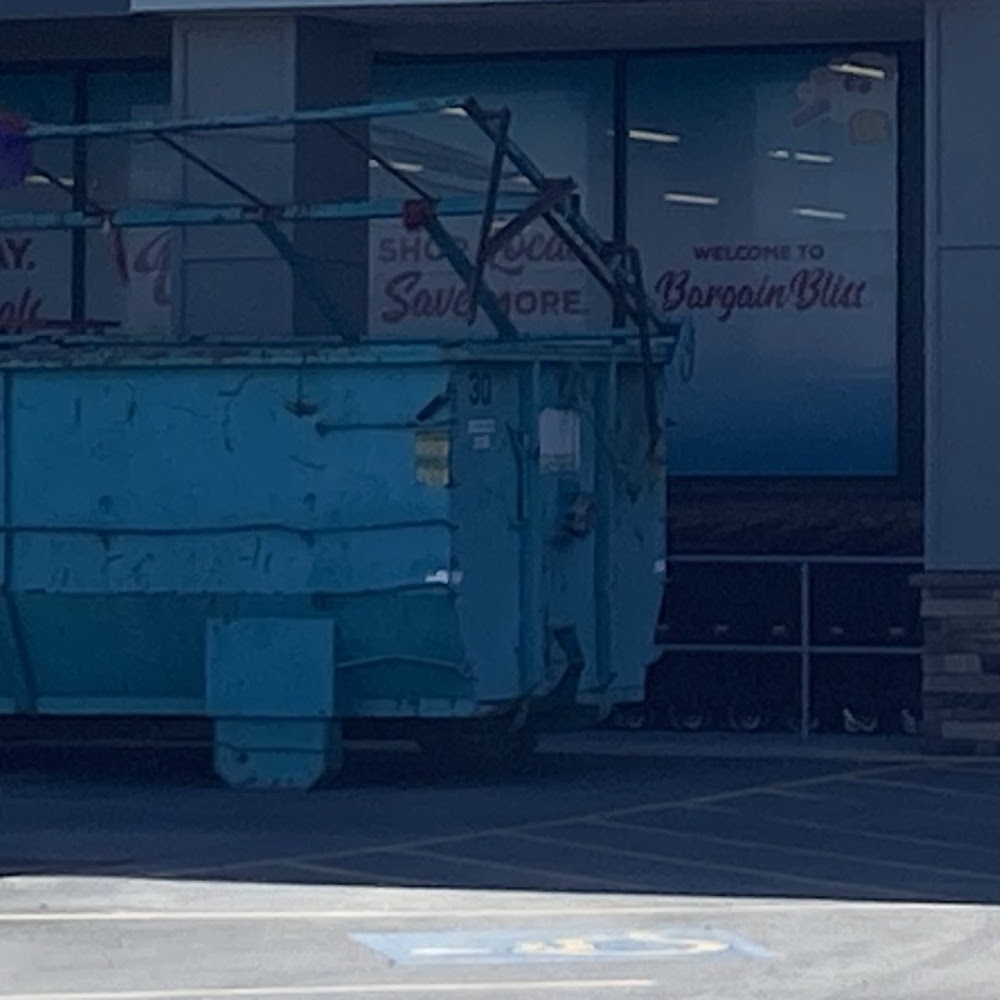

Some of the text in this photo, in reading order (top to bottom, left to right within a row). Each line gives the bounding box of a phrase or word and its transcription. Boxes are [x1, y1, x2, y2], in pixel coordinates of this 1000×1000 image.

[693, 244, 826, 262] WELCOME TO
[654, 268, 786, 322] Bargain
[468, 371, 492, 406] 30
